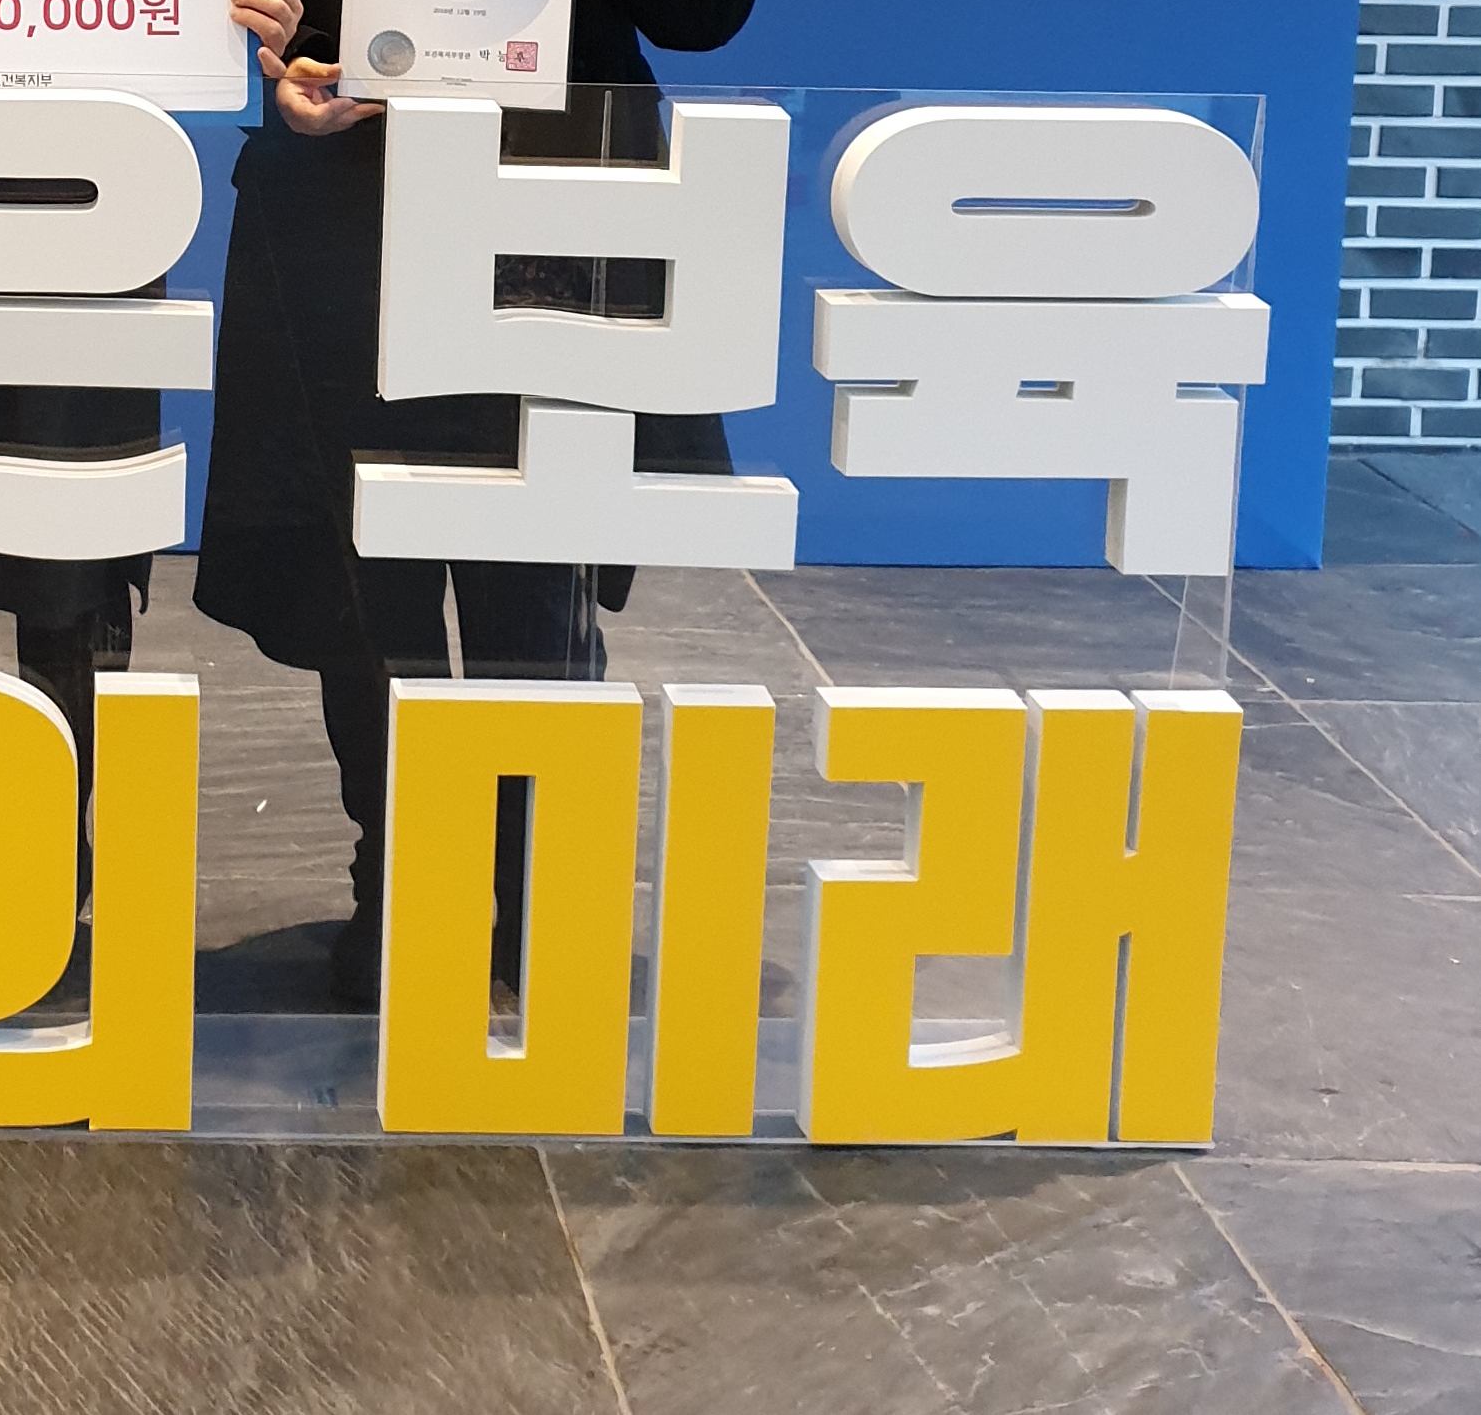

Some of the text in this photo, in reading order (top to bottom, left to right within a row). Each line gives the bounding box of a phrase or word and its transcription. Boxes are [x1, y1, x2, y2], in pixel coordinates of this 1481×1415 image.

[479, 49, 490, 61] 박
[353, 97, 1271, 576] 보육
[377, 677, 1244, 1145] 미래
